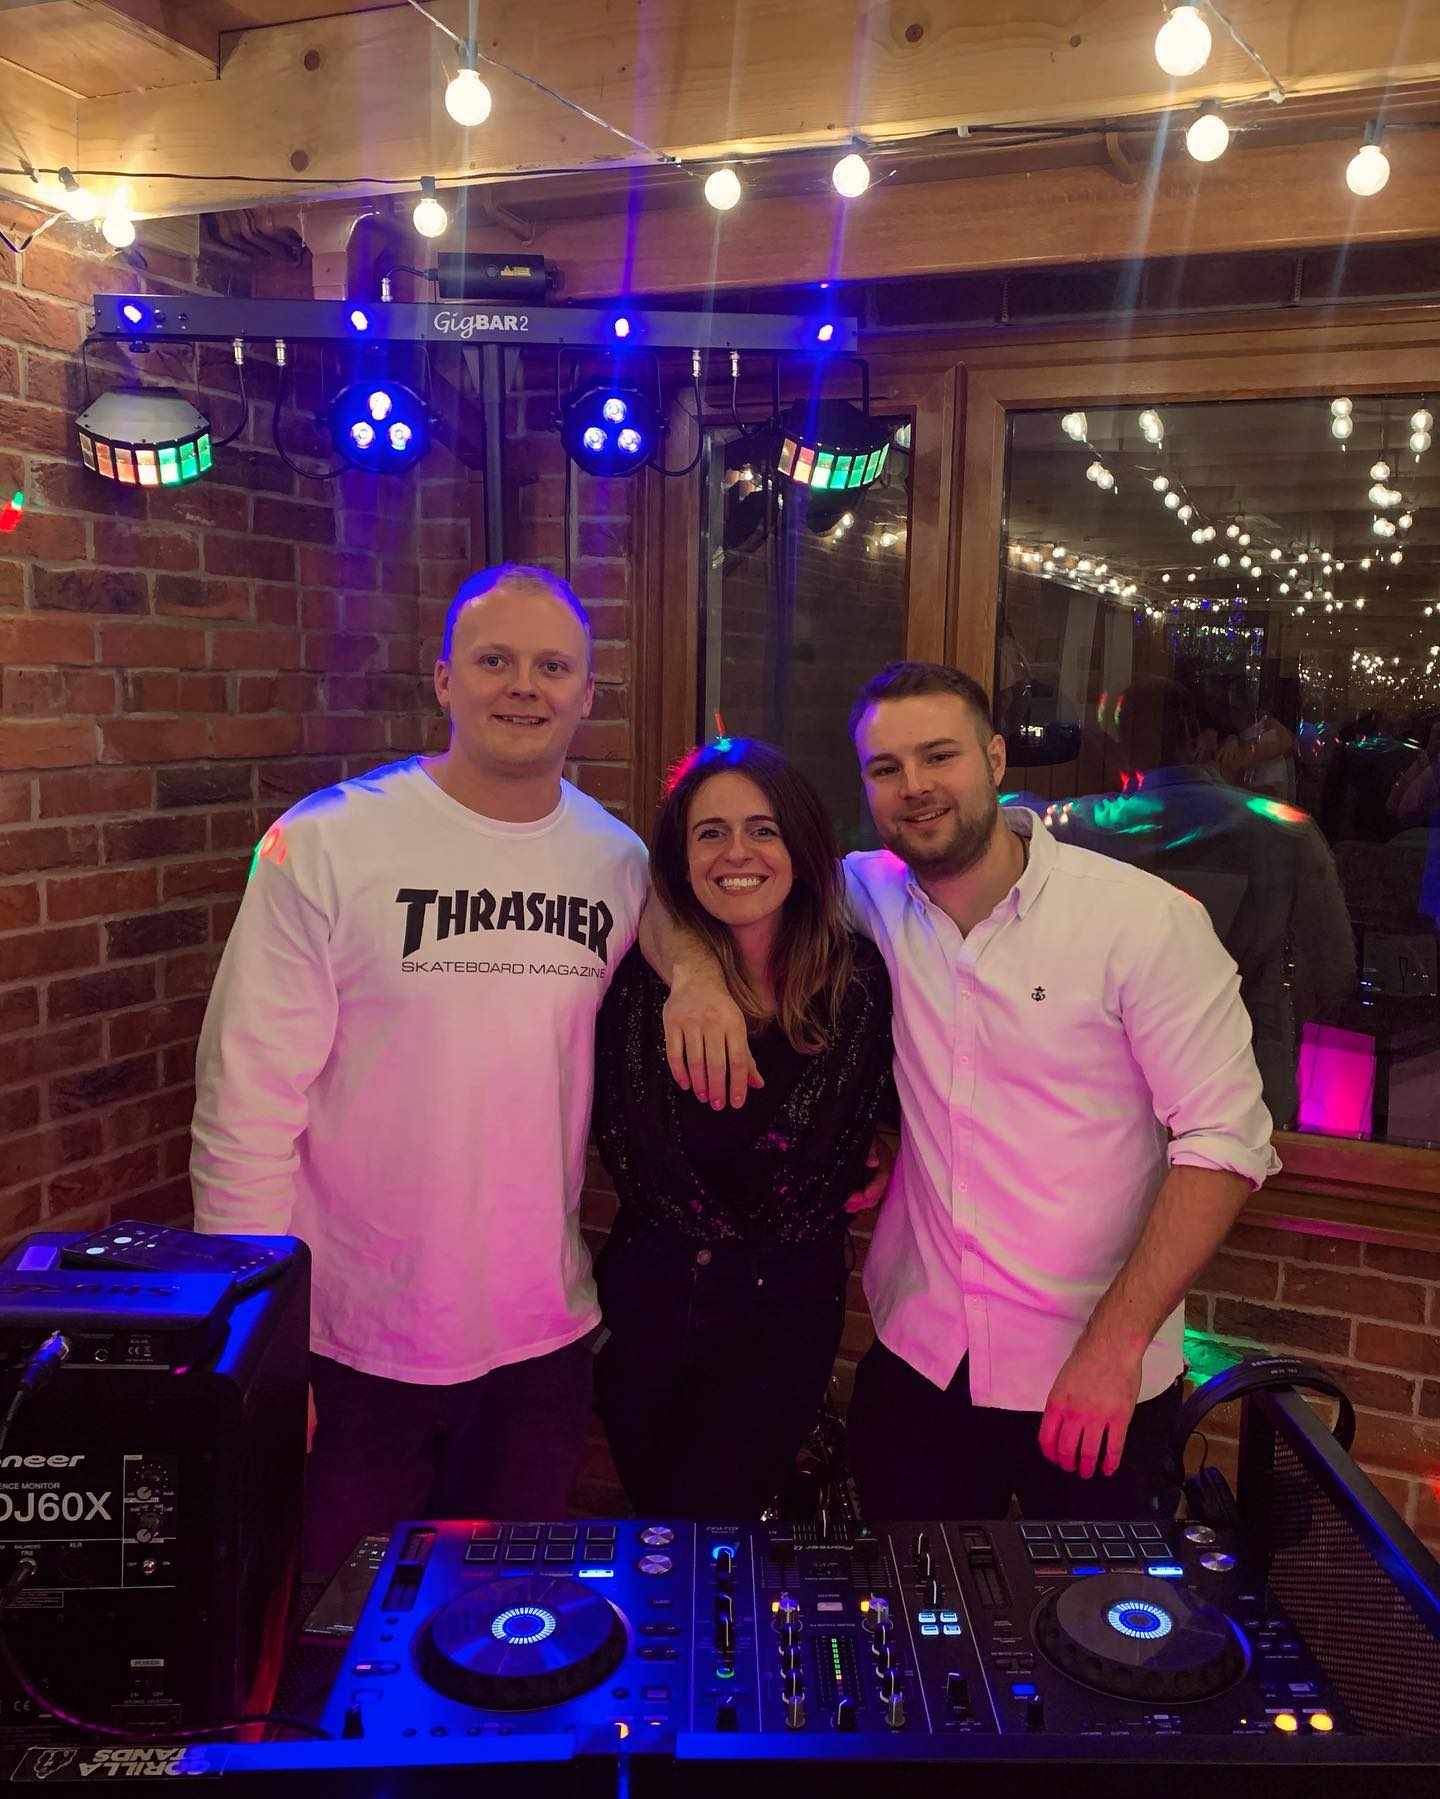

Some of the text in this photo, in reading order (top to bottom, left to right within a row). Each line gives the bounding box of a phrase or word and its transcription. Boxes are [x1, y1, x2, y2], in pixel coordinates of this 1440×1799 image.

[396, 888, 614, 966] THRASHER
[401, 961, 606, 979] SKATEBOARD MAGAZINE
[0, 1454, 86, 1468] neer
[21, 1481, 61, 1490] MONITOR
[79, 1760, 211, 1777] GORILLA
